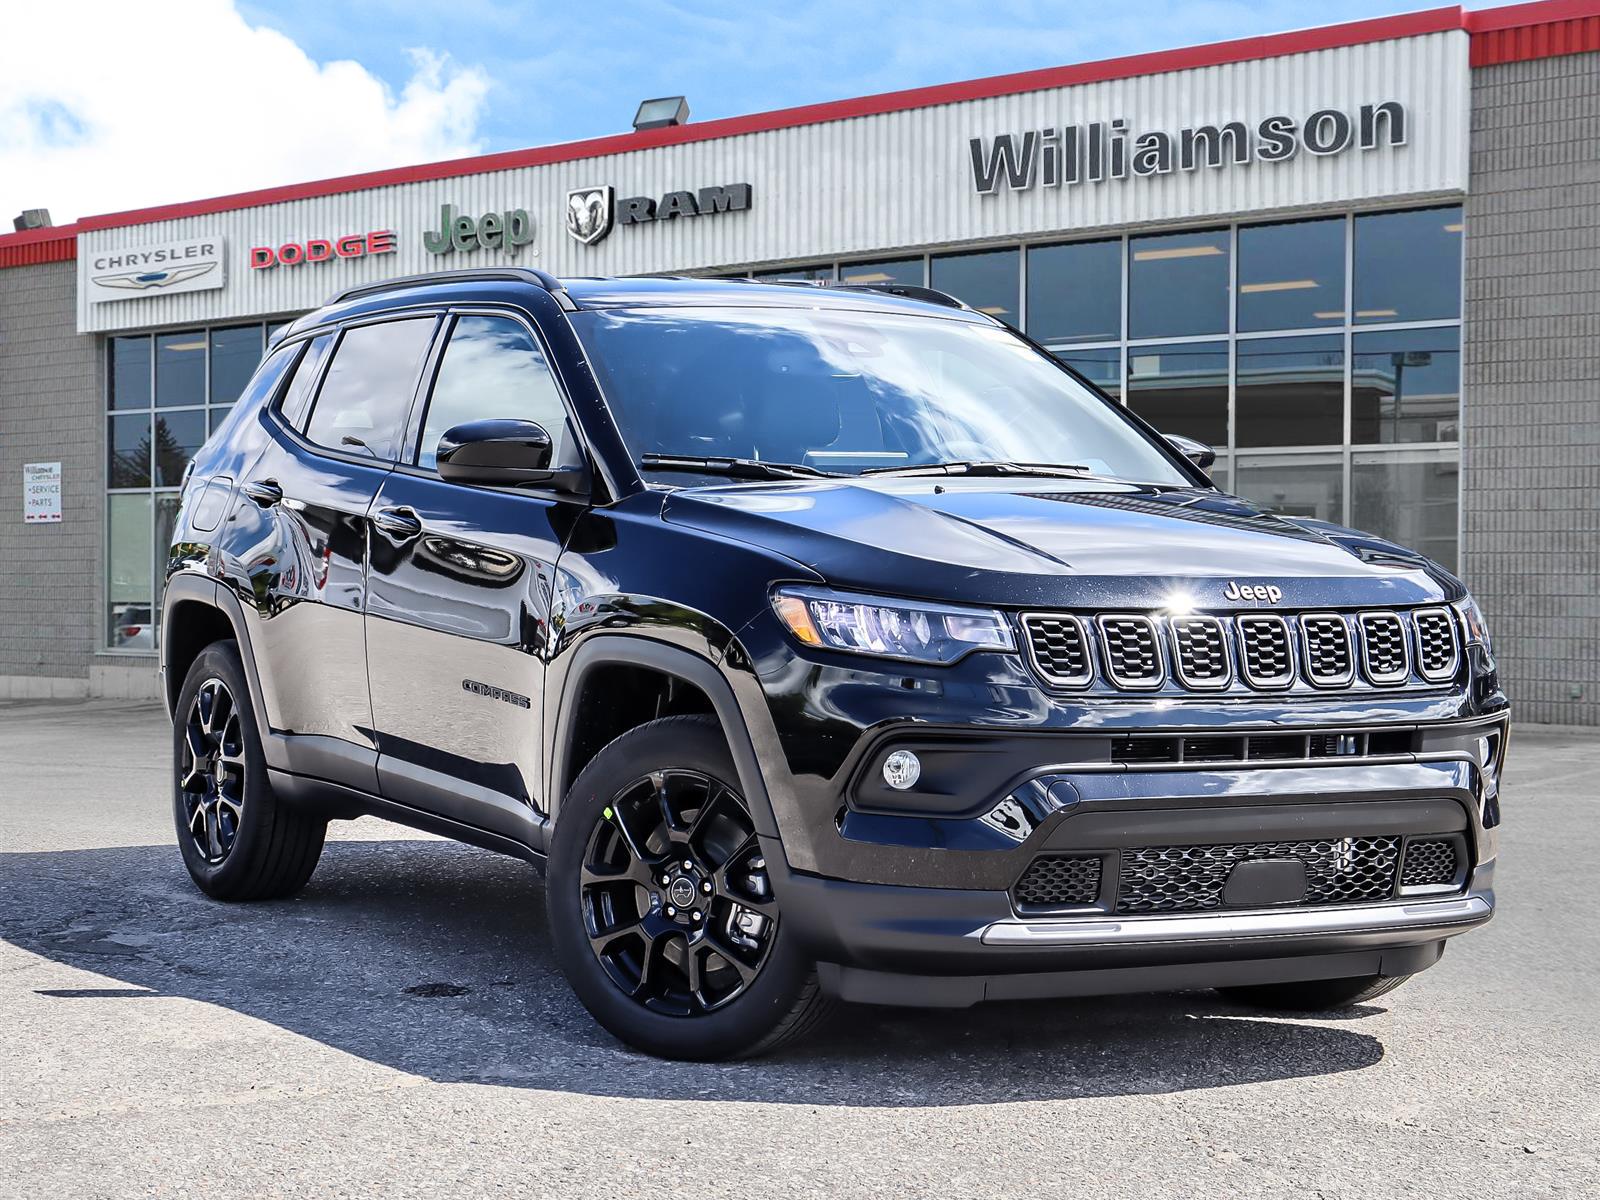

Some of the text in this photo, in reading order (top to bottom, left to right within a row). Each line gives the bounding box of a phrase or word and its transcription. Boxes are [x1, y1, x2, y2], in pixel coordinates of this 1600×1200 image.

[969, 99, 1408, 195] Williamson
[617, 182, 752, 225] RAM
[250, 230, 397, 271] DODGE
[423, 203, 535, 257] Jeep
[93, 243, 216, 271] CHRYSLER
[1223, 580, 1282, 604] Jeep
[462, 679, 531, 709] COMPASS
